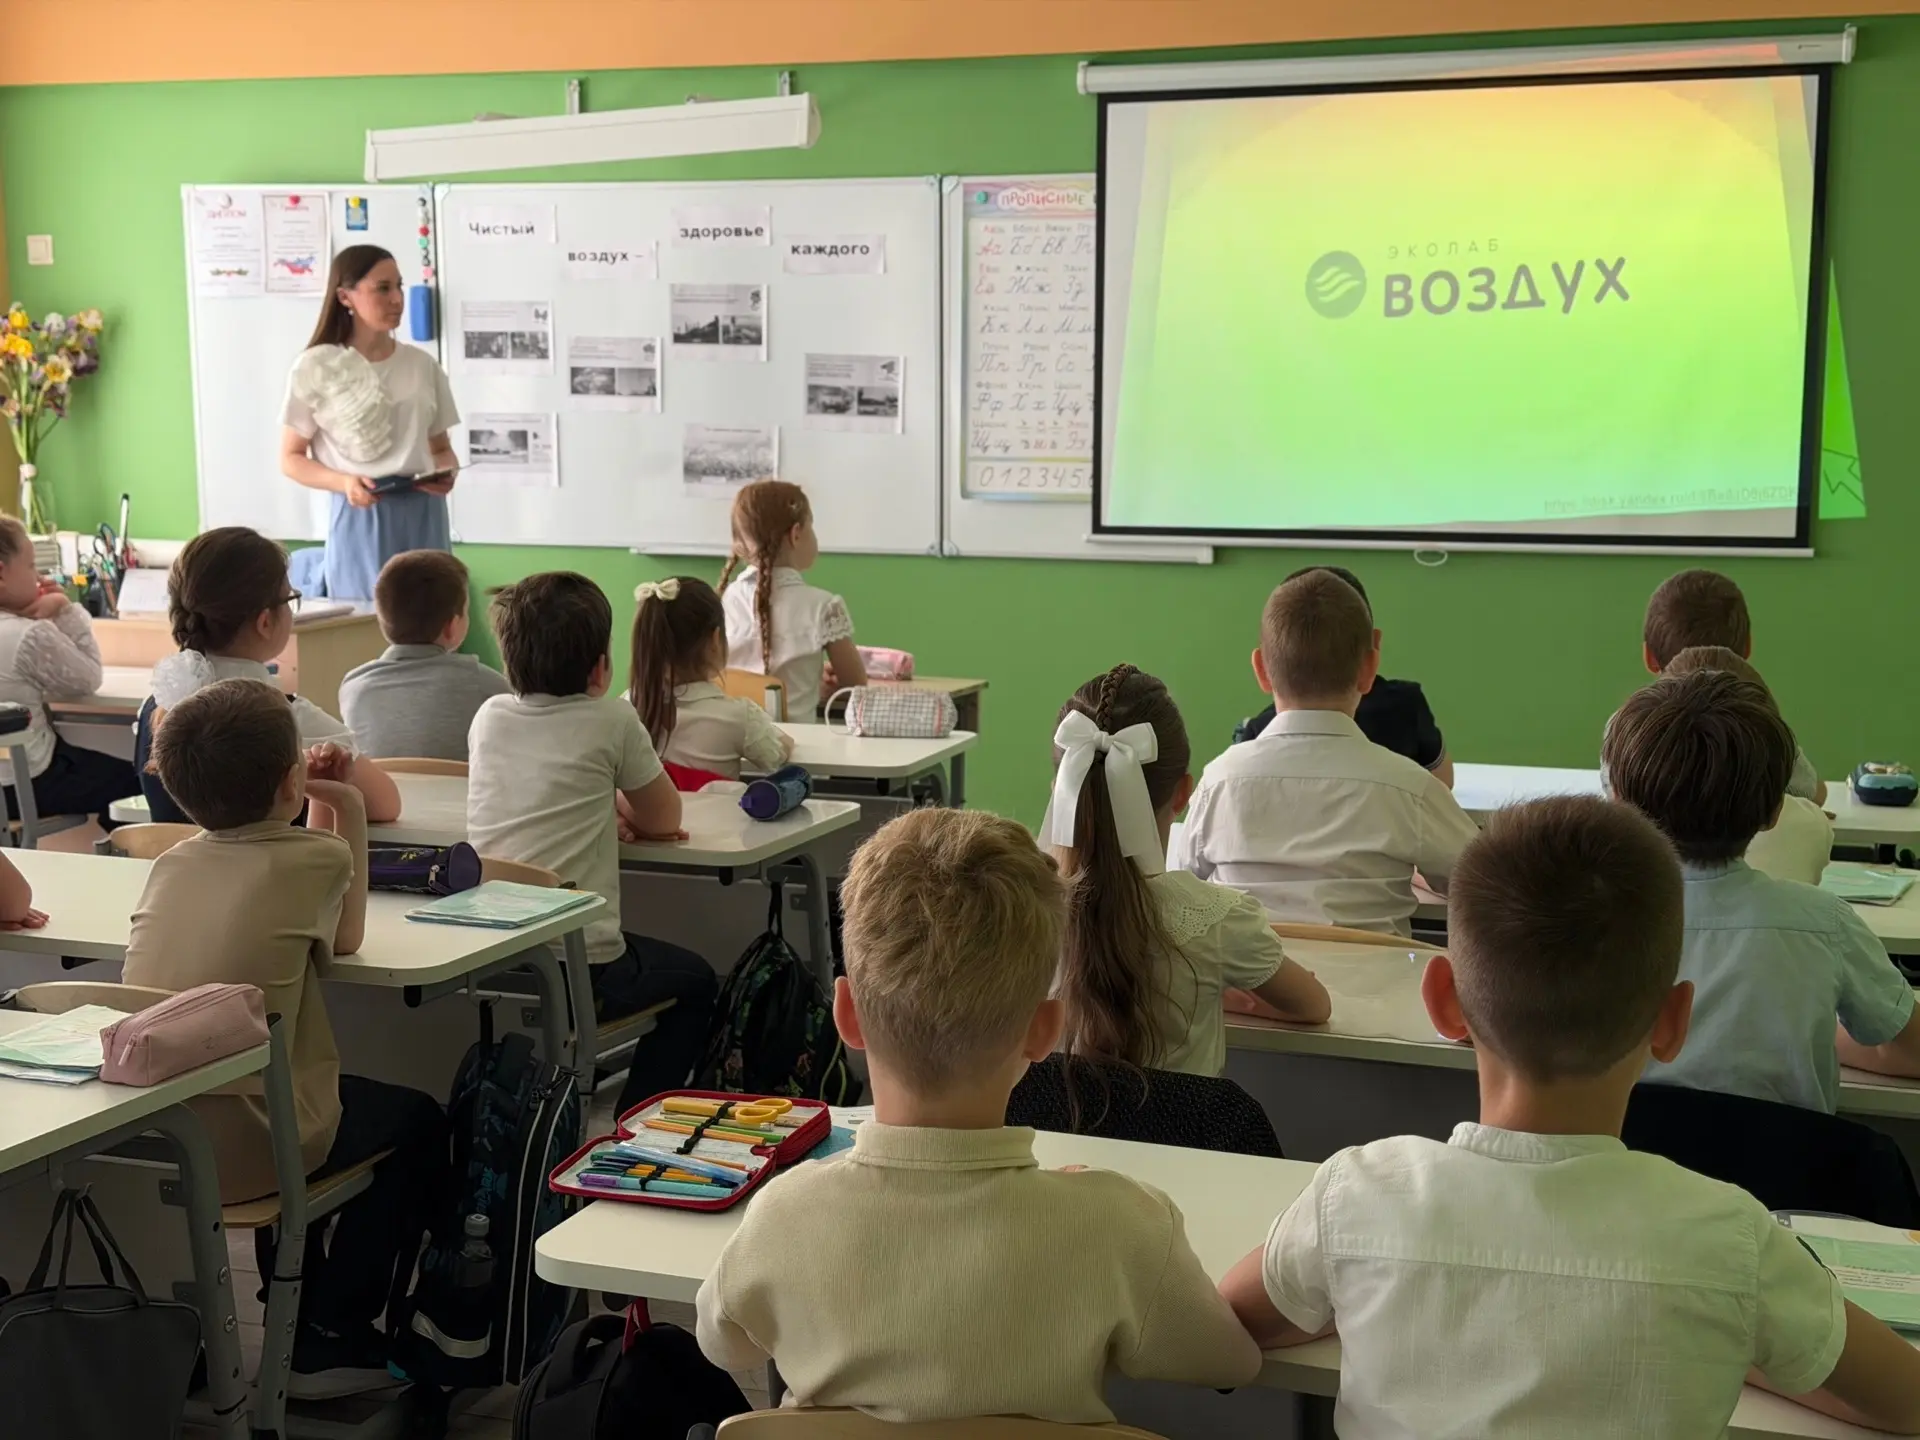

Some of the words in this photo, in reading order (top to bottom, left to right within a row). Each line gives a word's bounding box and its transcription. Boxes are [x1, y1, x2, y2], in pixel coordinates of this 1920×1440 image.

[1001, 192, 1087, 207] ПРОПИСНЫЕ
[468, 221, 535, 235] Чистый
[680, 226, 764, 241] здоровье
[790, 243, 870, 257] каждого
[1388, 238, 1499, 259] ЭКОЛАБ
[568, 251, 630, 265] воздух
[1383, 256, 1630, 318] ВОЗДУХ
